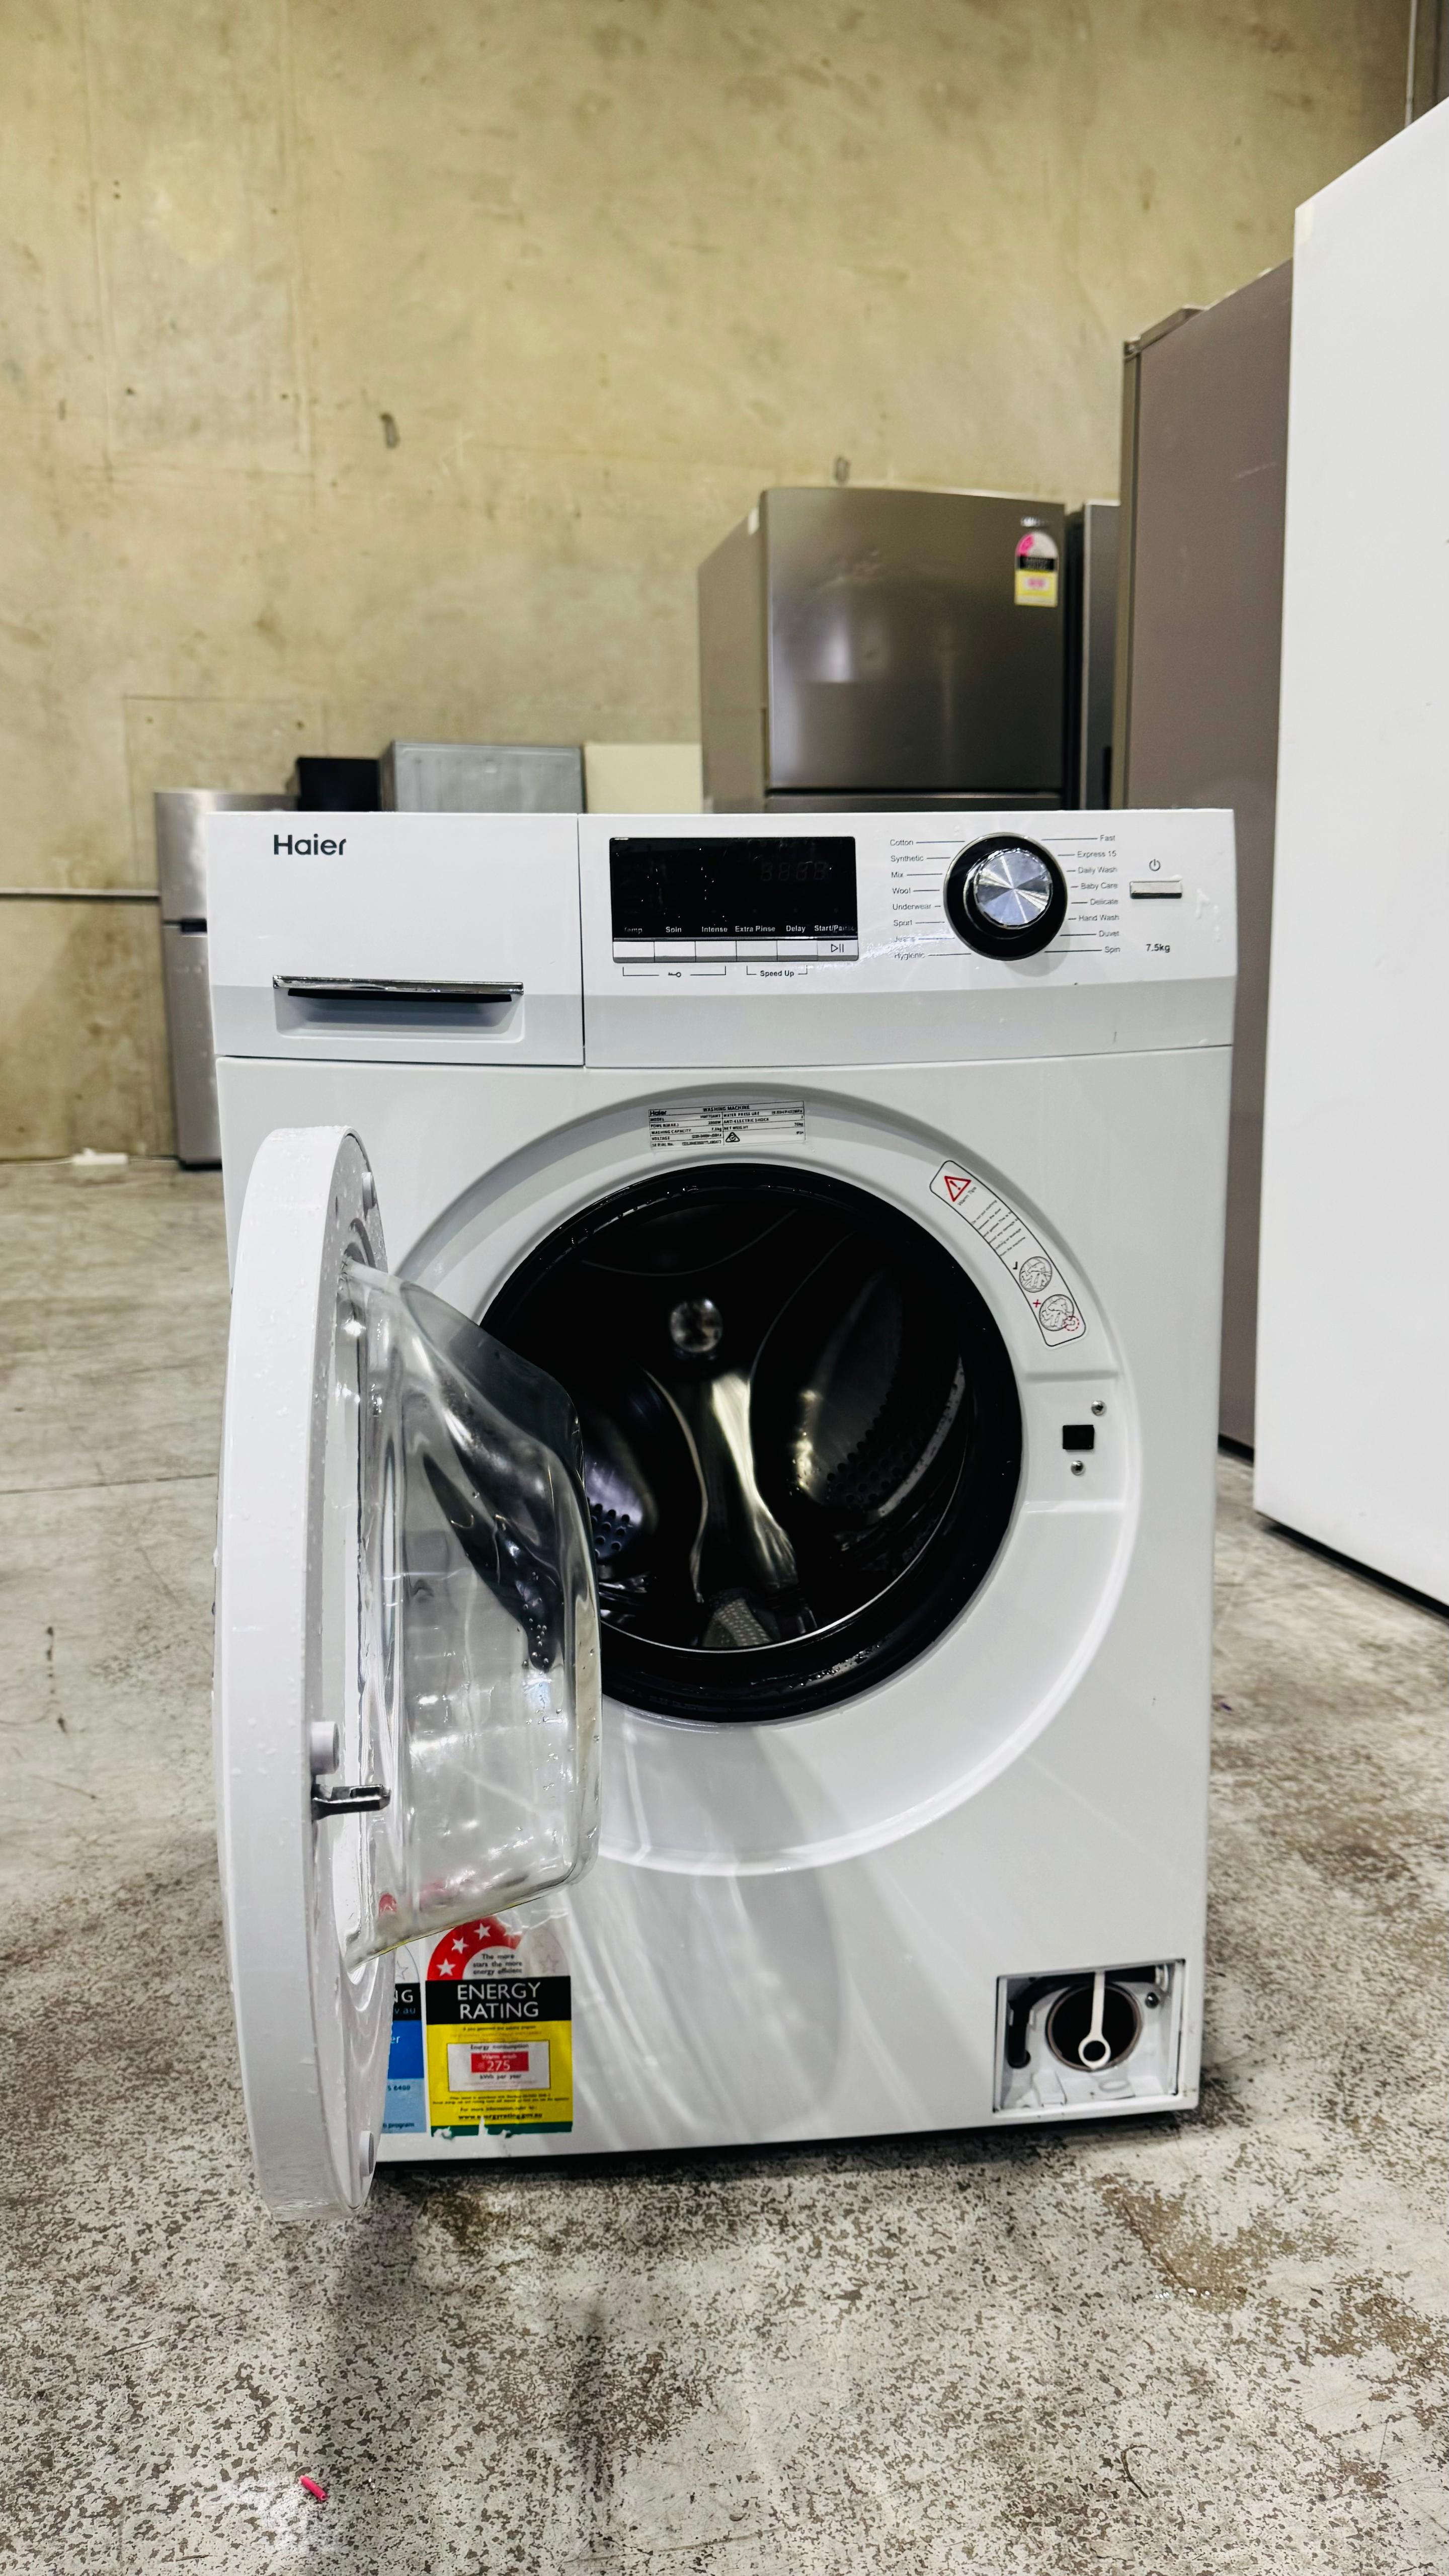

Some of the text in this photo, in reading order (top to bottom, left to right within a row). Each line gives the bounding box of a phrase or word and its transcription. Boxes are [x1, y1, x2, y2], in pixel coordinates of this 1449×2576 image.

[274, 833, 347, 855] Haier
[891, 855, 924, 863] Synthetic
[1078, 866, 1095, 875] Daily
[1080, 882, 1099, 891] Baby
[785, 925, 806, 933] Delay
[1146, 943, 1170, 953] 7.5kg
[457, 1982, 541, 2000] ENERGY
[460, 2001, 539, 2020] RATING
[487, 2060, 511, 2071] 275
